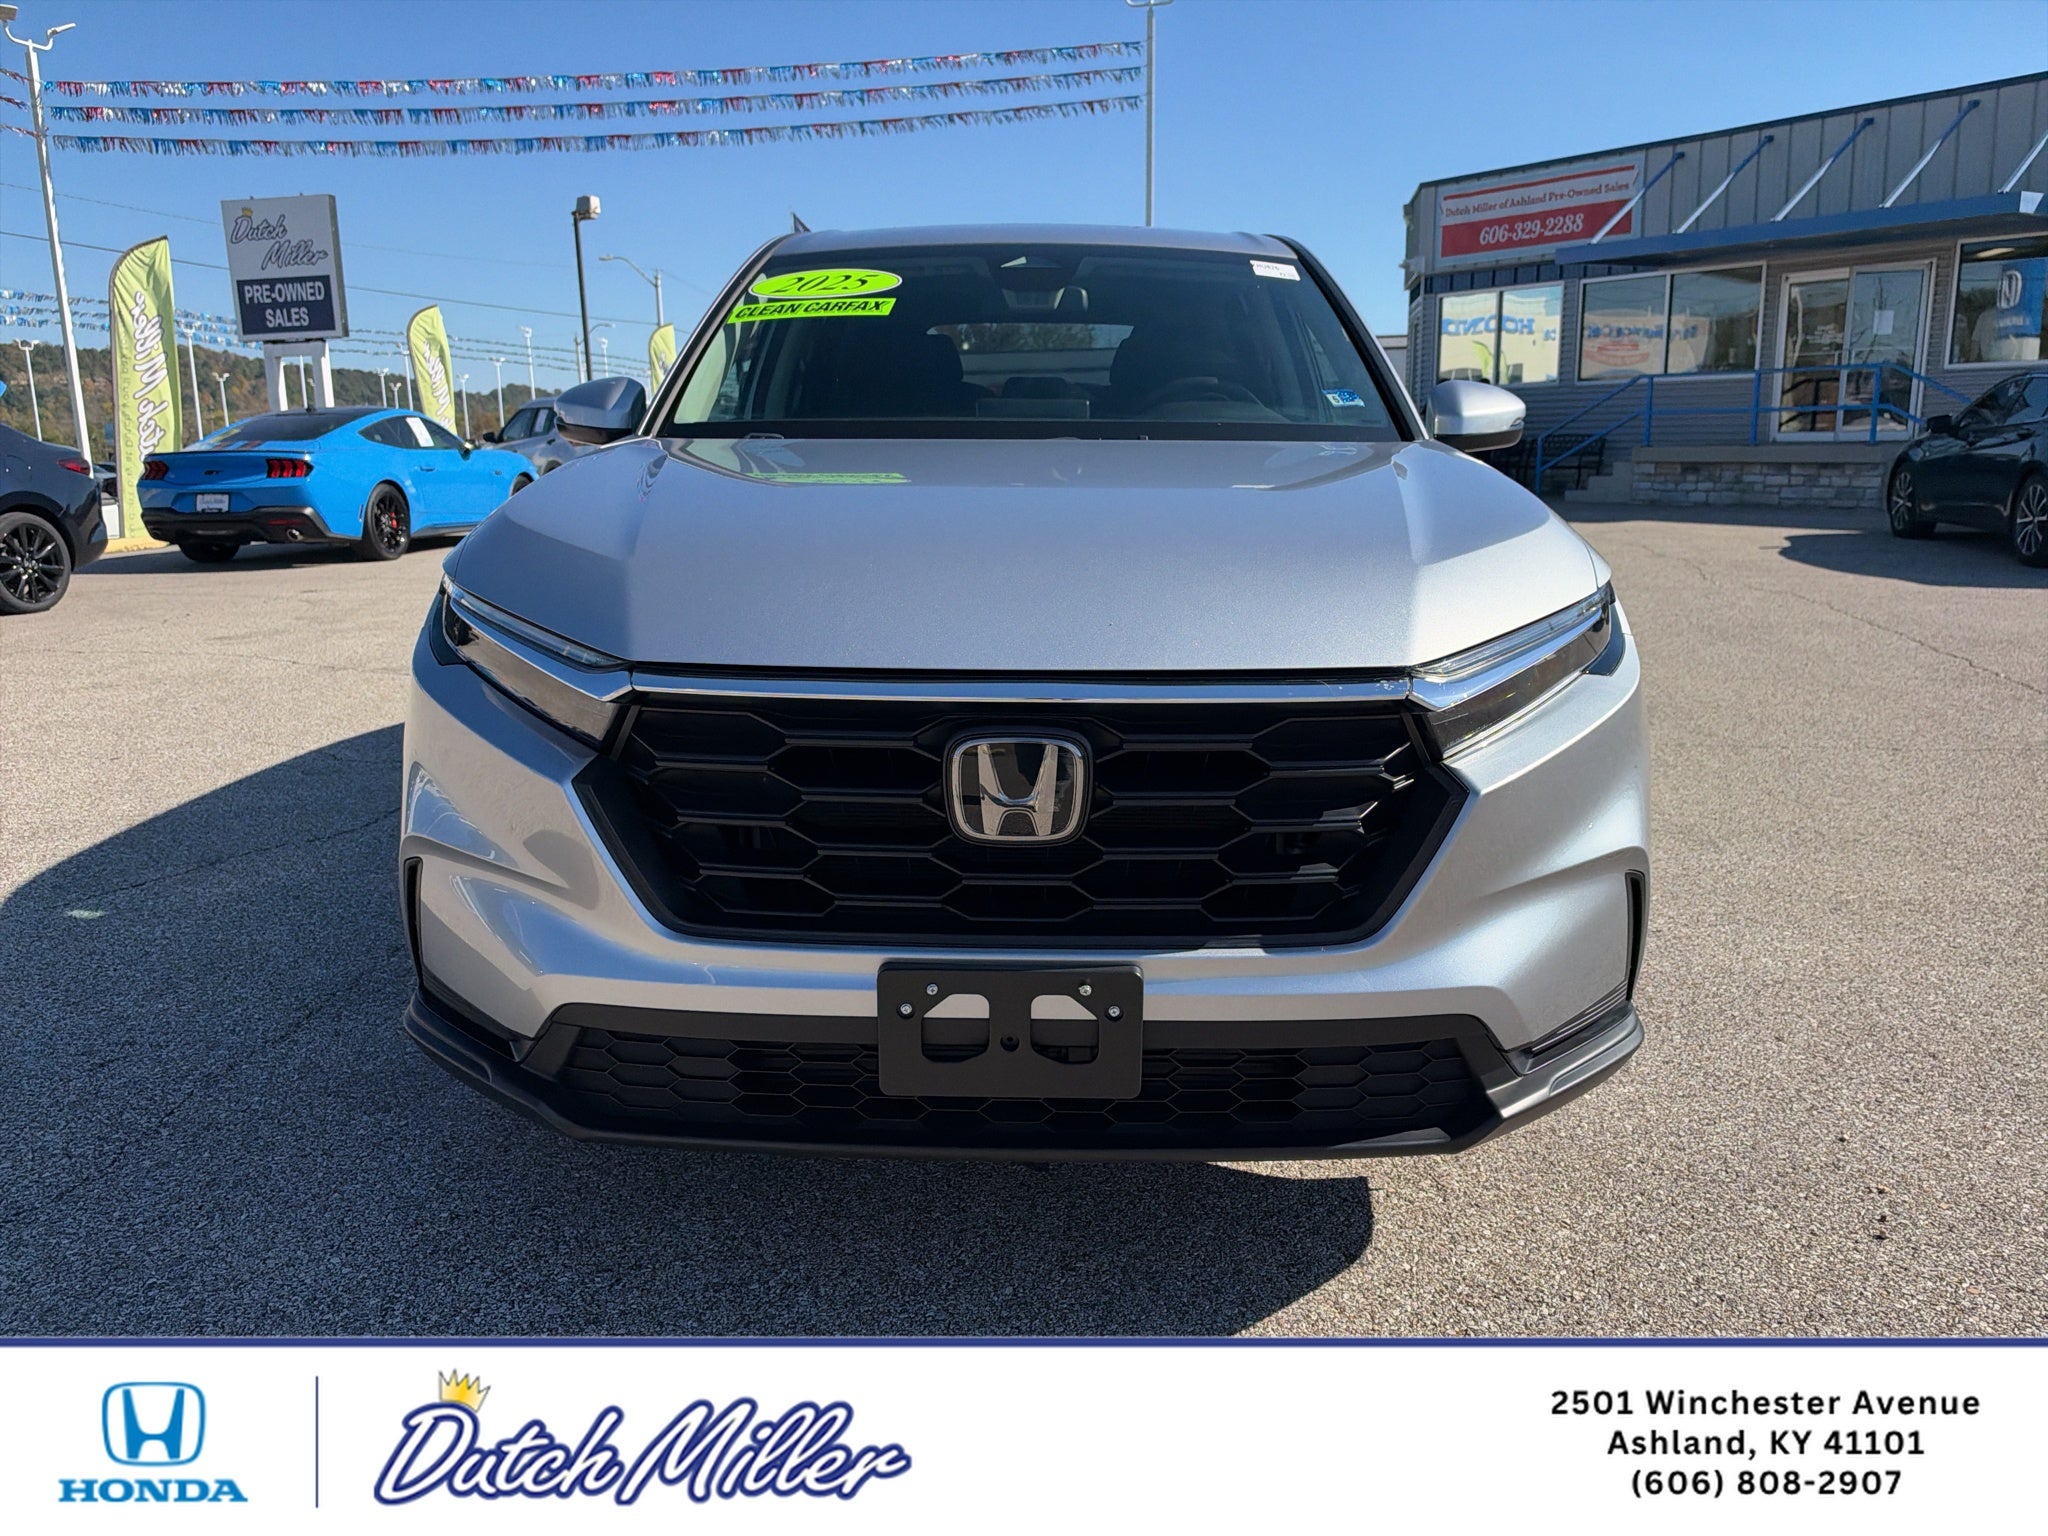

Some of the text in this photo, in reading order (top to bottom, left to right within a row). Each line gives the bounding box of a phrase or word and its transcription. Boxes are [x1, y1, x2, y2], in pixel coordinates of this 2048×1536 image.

[1445, 183, 1630, 217] Dutch Miller of Ashland Pre-Owned Sales
[231, 214, 287, 244] Dutch
[1479, 213, 1585, 245] 606-329-2288
[261, 239, 329, 271] Miller
[244, 281, 325, 305] PRE-OWNED
[769, 274, 881, 294] 2025
[265, 306, 310, 328] SALES
[735, 299, 888, 319] CLEAN CARFAX
